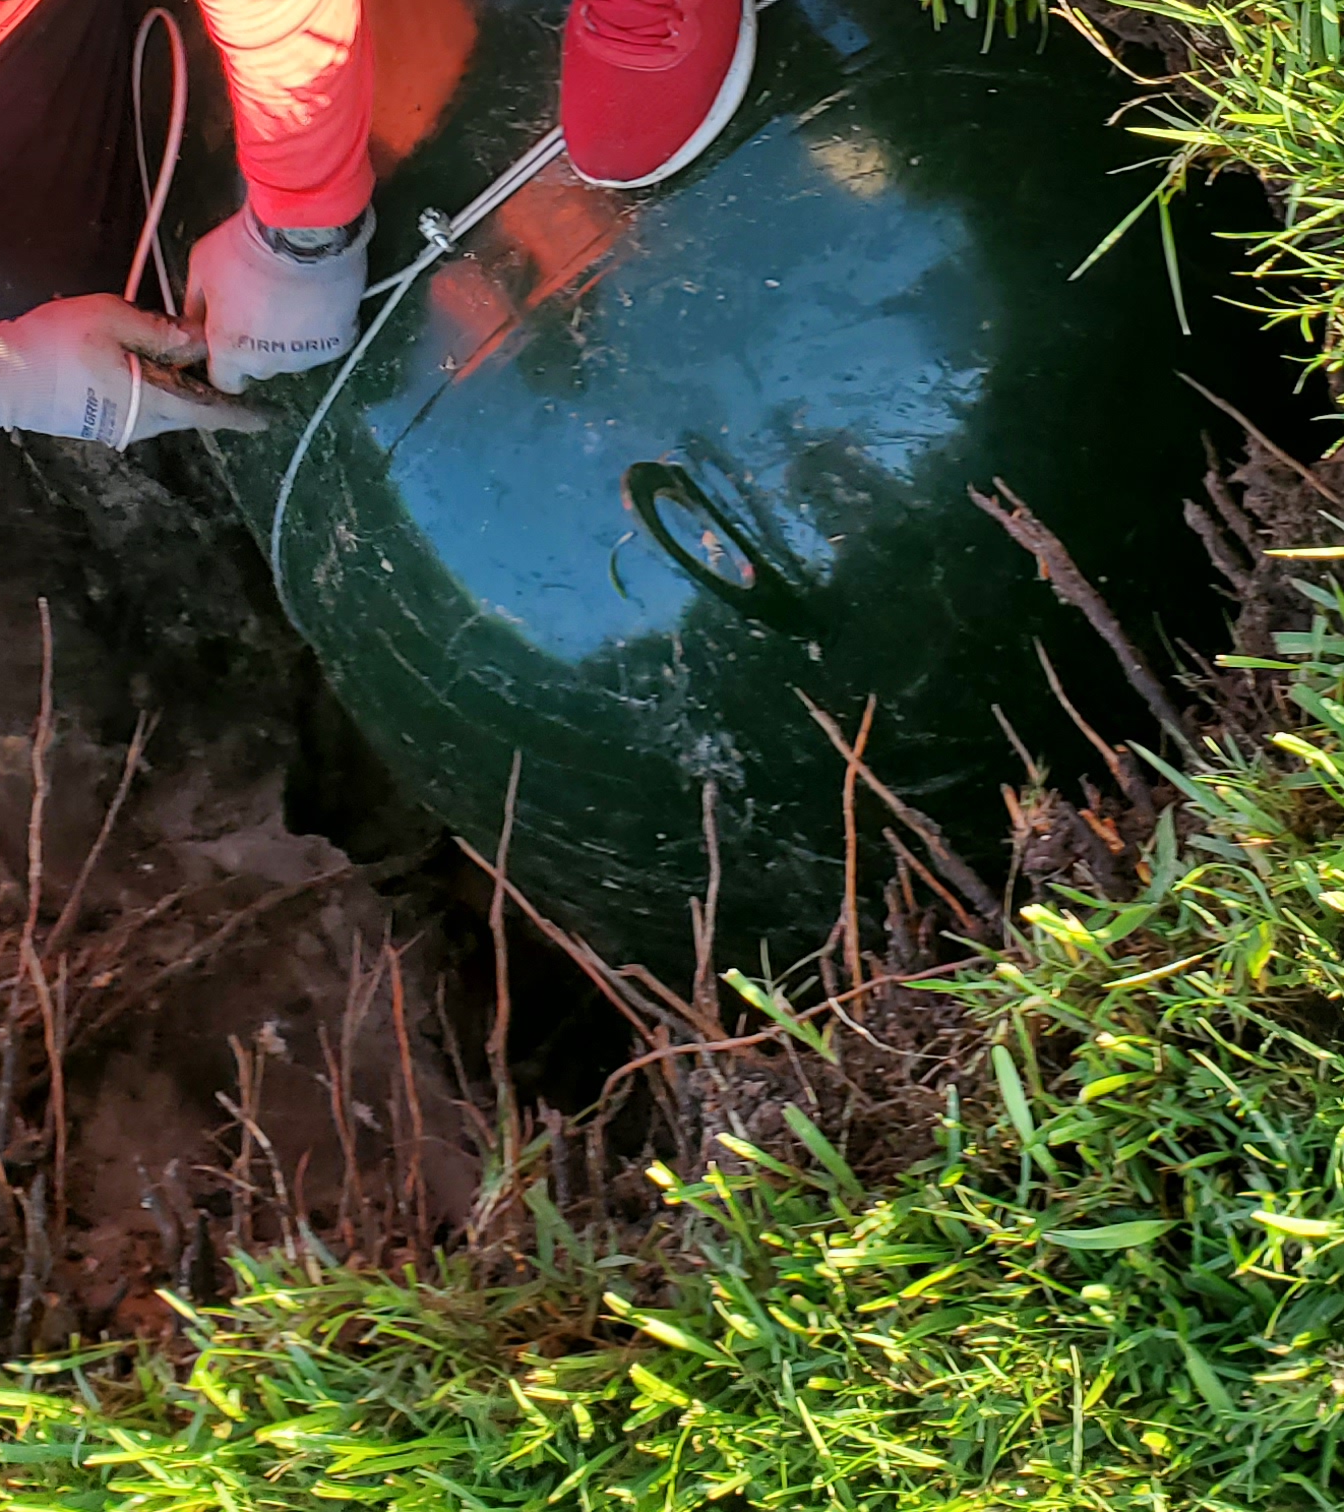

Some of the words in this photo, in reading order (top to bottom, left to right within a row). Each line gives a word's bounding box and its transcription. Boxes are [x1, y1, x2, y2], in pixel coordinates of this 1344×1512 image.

[238, 334, 285, 353] FIRM
[290, 336, 340, 352] GRIP
[84, 387, 98, 426] GRIP
